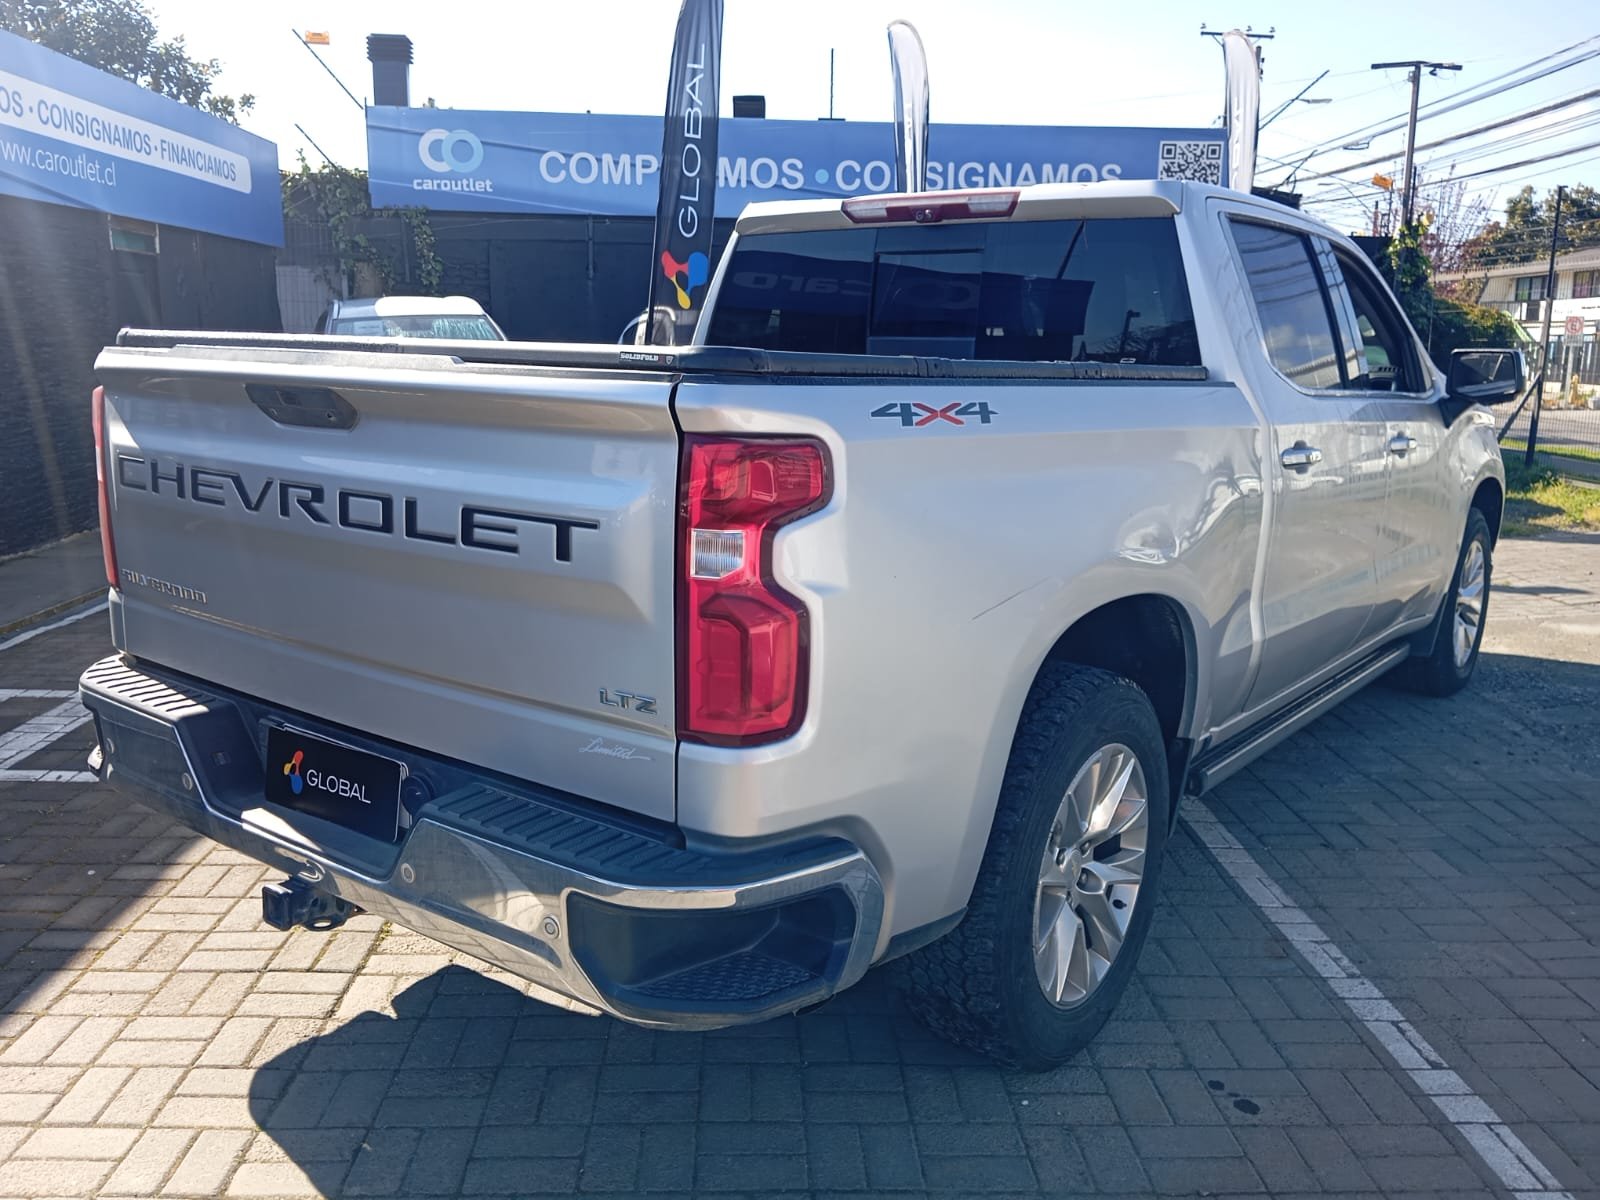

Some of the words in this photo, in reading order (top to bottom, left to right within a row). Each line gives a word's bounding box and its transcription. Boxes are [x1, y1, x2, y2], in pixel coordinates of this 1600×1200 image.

[37, 99, 152, 156] CONSIGNAMOS
[160, 139, 237, 182] FINANCIAMOS
[678, 43, 705, 238] GLOBAL
[412, 177, 494, 193] caroutlet
[539, 151, 805, 190] COMPMOS
[835, 159, 1123, 192] COSIGNAMOS
[118, 453, 601, 564] CHEVROLET
[599, 687, 658, 715] LTZ
[306, 769, 372, 804] GLOBAL
